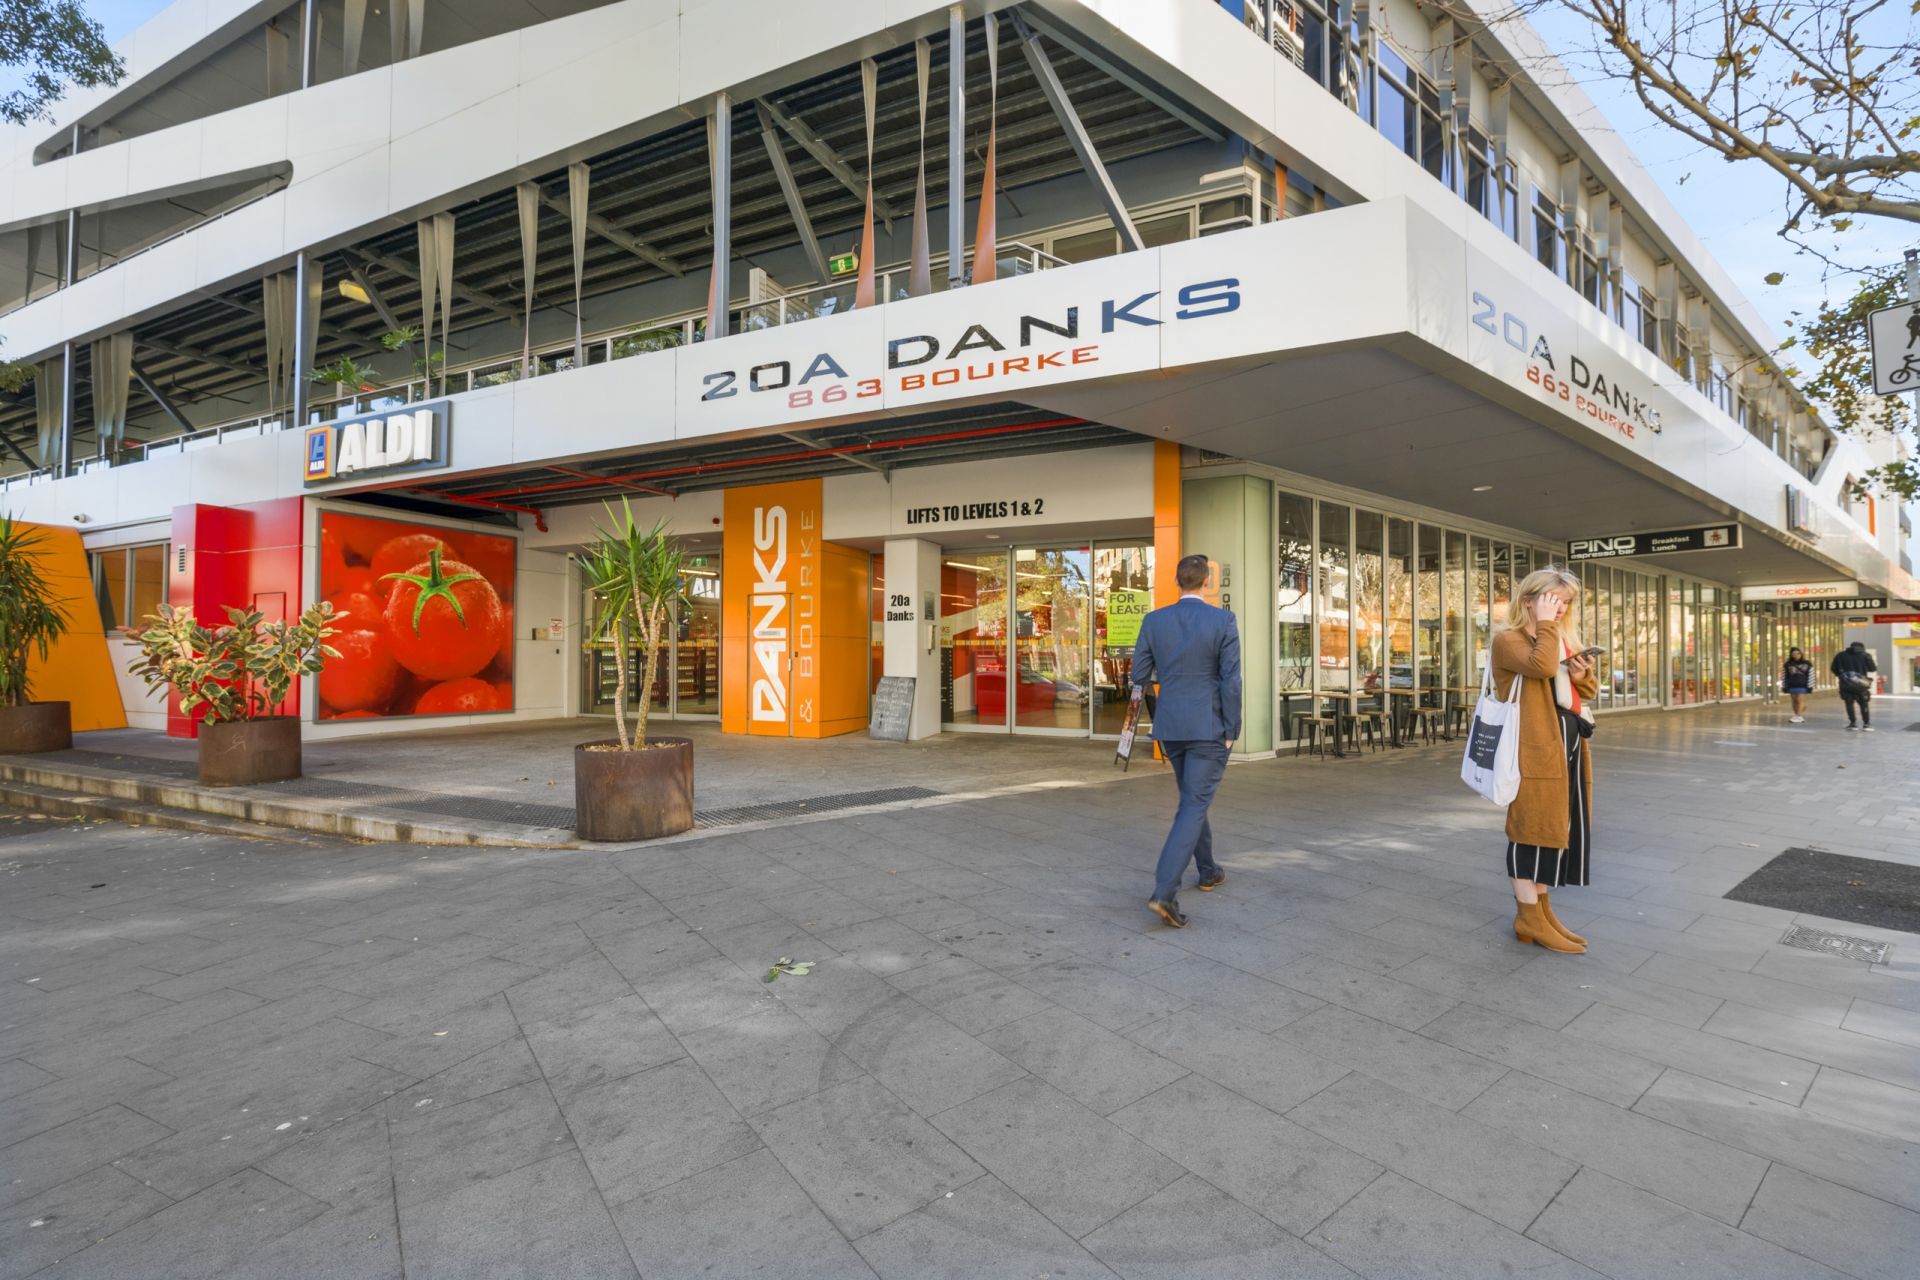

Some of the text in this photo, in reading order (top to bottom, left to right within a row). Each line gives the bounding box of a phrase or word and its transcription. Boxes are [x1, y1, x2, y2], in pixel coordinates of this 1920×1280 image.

[701, 278, 1240, 401] 20A DANKS
[1473, 291, 1662, 434] 20A DANKS
[788, 345, 1099, 409] 863 BOURKE
[1526, 364, 1635, 439] 863 BOURKE
[336, 409, 433, 473] ALDI
[309, 460, 325, 472] ALDI
[907, 498, 1044, 524] LIFTS TO LEVELS 1 & 2
[1570, 536, 1636, 554] PINO
[1651, 535, 1690, 545] Breakfast
[1570, 548, 1637, 560] espresso bar
[1651, 544, 1677, 552] Lunch
[890, 594, 910, 607] 20a
[1109, 593, 1135, 603] FOR
[1799, 599, 1880, 610] PM STUDIO
[752, 505, 787, 722] DANKS
[799, 509, 815, 723] & BOURKE
[887, 611, 915, 622] Danks
[1109, 604, 1148, 615] LEASE
